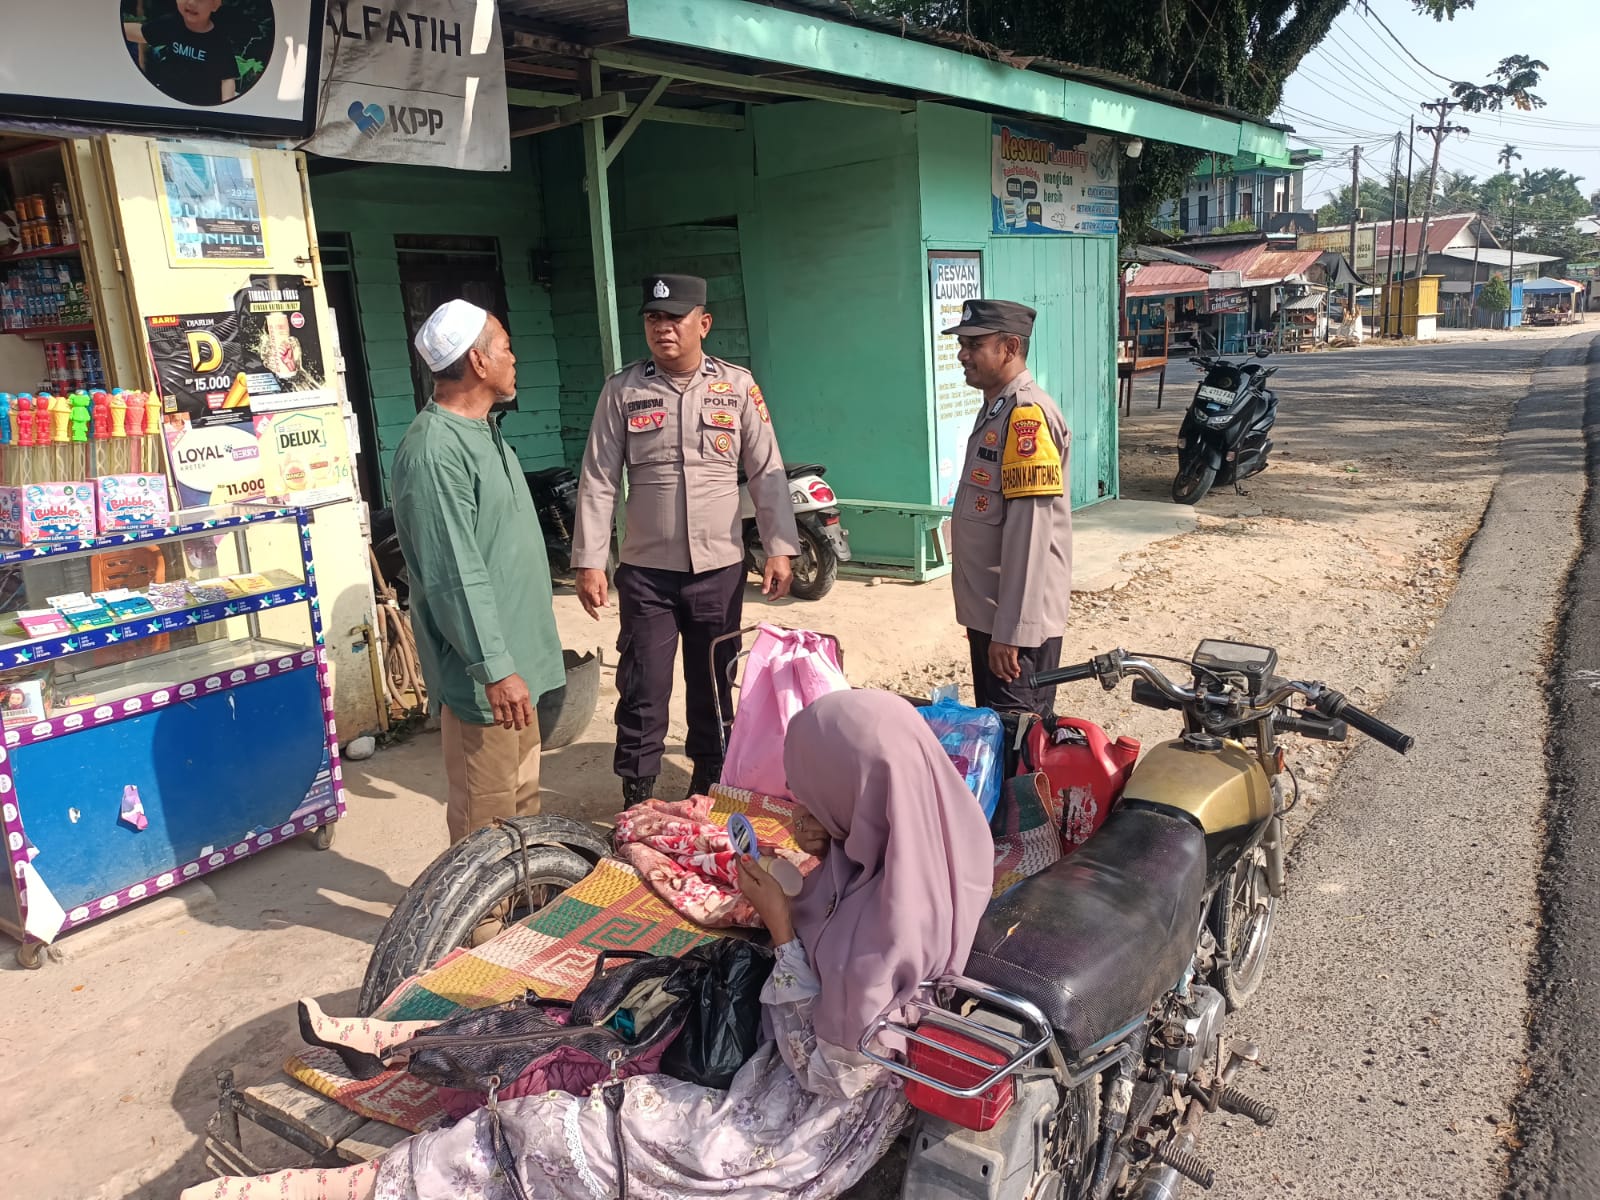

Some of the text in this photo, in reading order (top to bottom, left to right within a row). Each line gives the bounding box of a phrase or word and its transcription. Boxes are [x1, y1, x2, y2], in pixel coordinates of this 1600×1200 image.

[173, 41, 207, 62] SMILE
[389, 105, 443, 136] KPP
[935, 282, 979, 300] LAUNDRY
[151, 316, 176, 325] BARU
[186, 318, 214, 328] DJARUM
[184, 329, 224, 374] D
[194, 375, 231, 391] 15.000
[704, 398, 737, 408] POLRI
[280, 429, 321, 449] DELUX
[178, 445, 224, 464] LOYAL
[226, 478, 265, 496] 11.000
[34, 505, 80, 519] Bubbles
[110, 496, 153, 510] Bubbles
